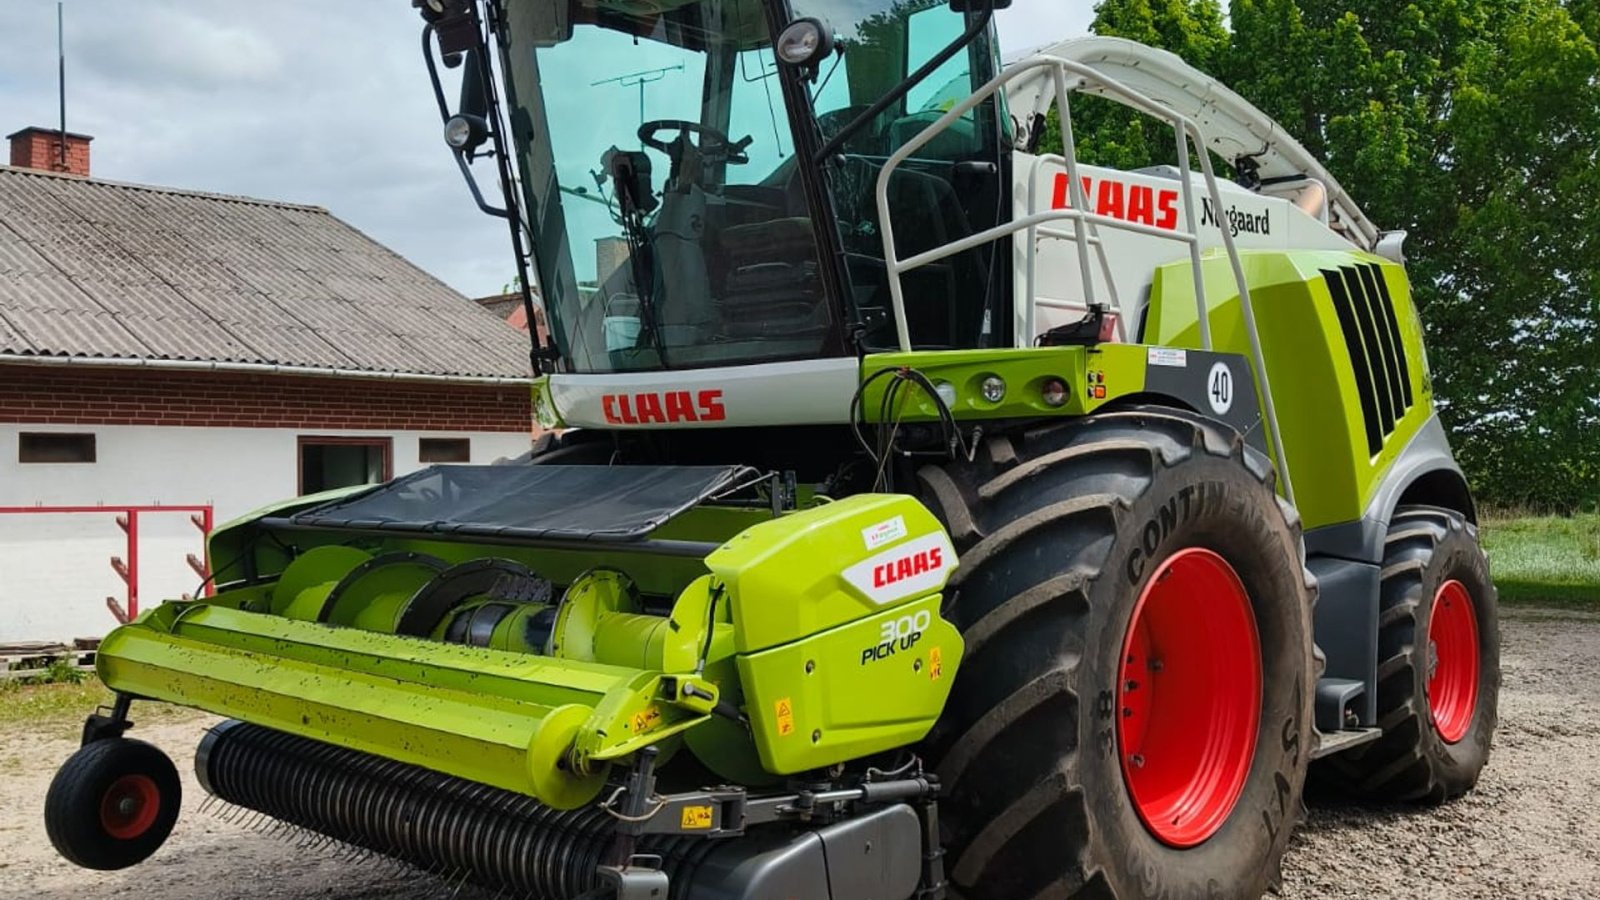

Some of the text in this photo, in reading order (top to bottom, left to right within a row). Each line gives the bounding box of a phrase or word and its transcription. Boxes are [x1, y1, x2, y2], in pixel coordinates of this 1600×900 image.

[1052, 172, 1178, 231] CAAS
[1201, 196, 1270, 238] Ngaard
[1211, 371, 1229, 404] 40
[602, 389, 727, 425] CLAAS
[873, 547, 943, 589] CLAAS
[880, 609, 931, 647] 300
[860, 631, 922, 666] PICK UP
